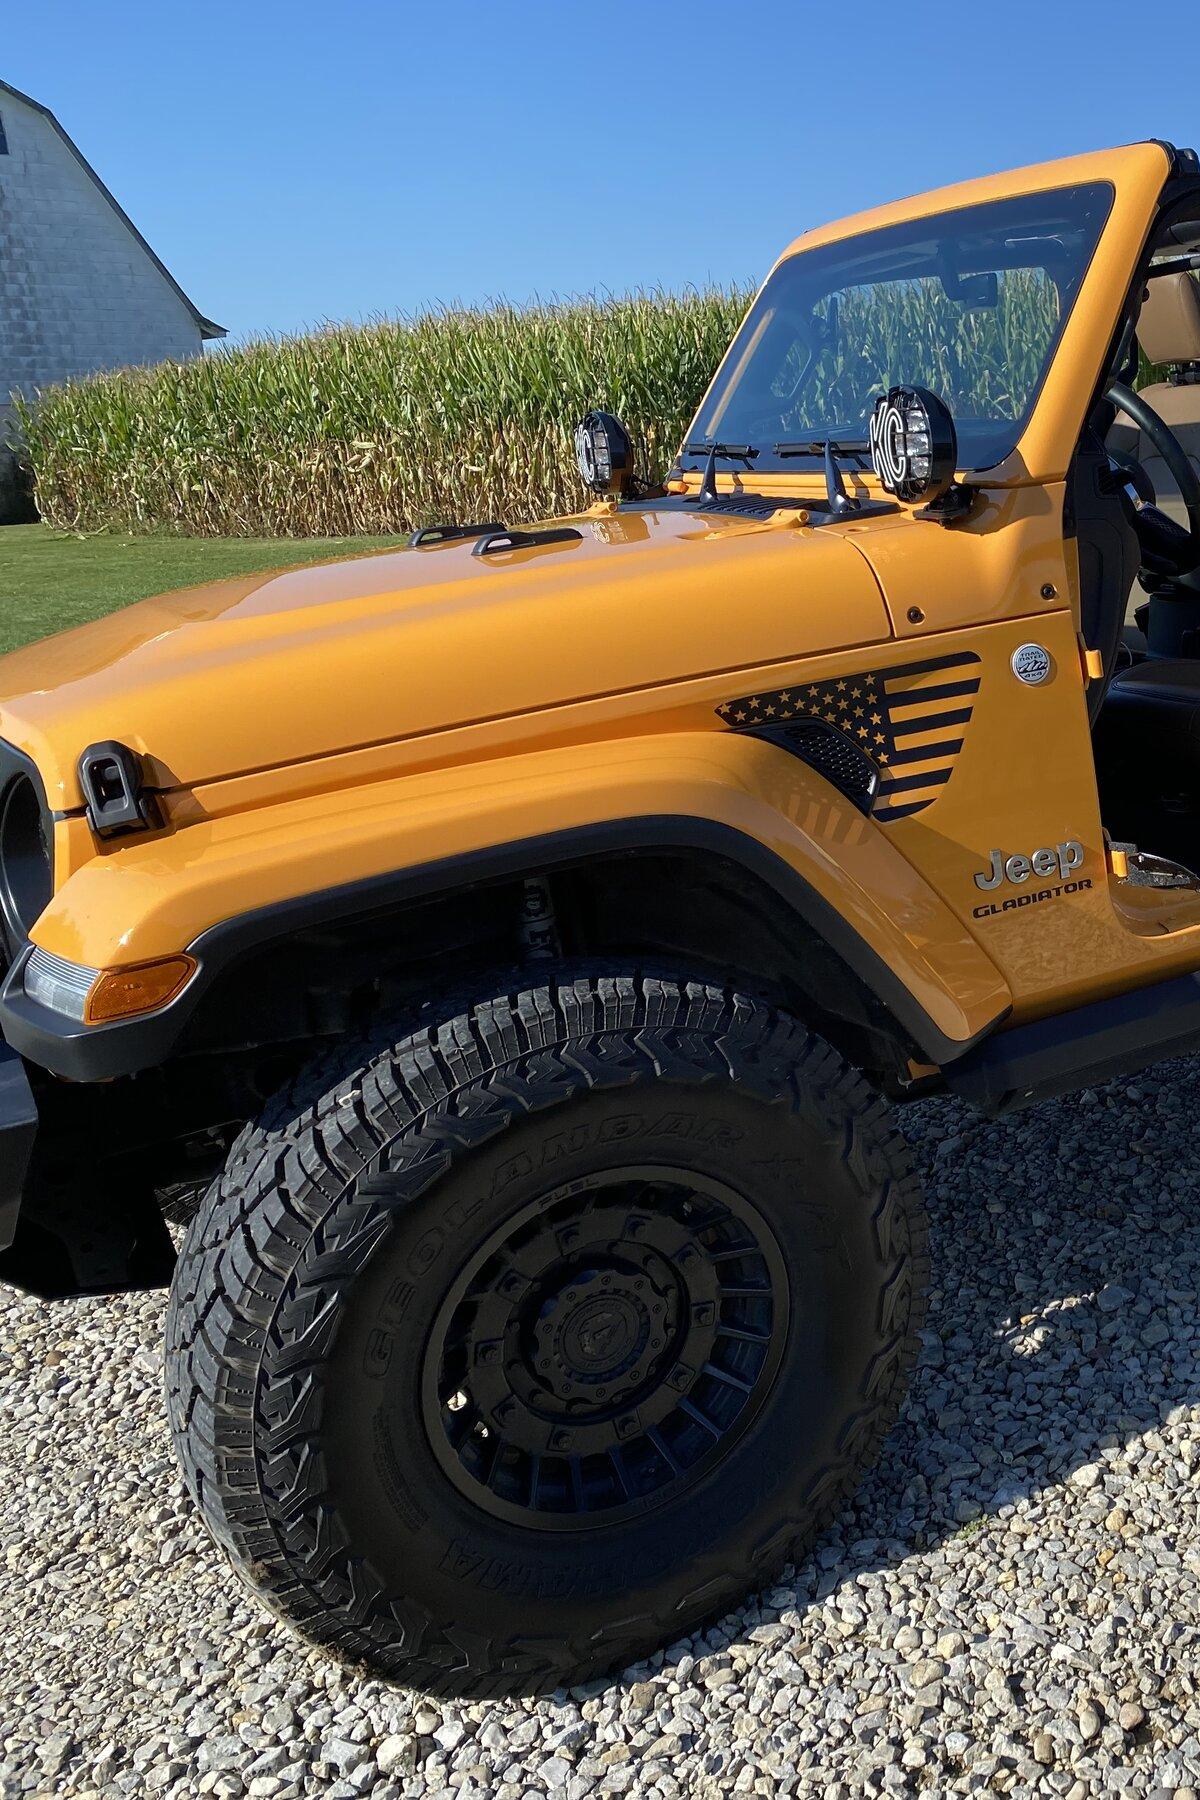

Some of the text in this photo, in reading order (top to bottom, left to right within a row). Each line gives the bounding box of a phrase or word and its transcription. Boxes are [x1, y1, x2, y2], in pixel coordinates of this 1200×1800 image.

[869, 401, 906, 488] KC
[973, 878, 1093, 919] GLADIATOR
[974, 841, 1084, 892] Jeep
[363, 1109, 745, 1380] GEOLANDAR
